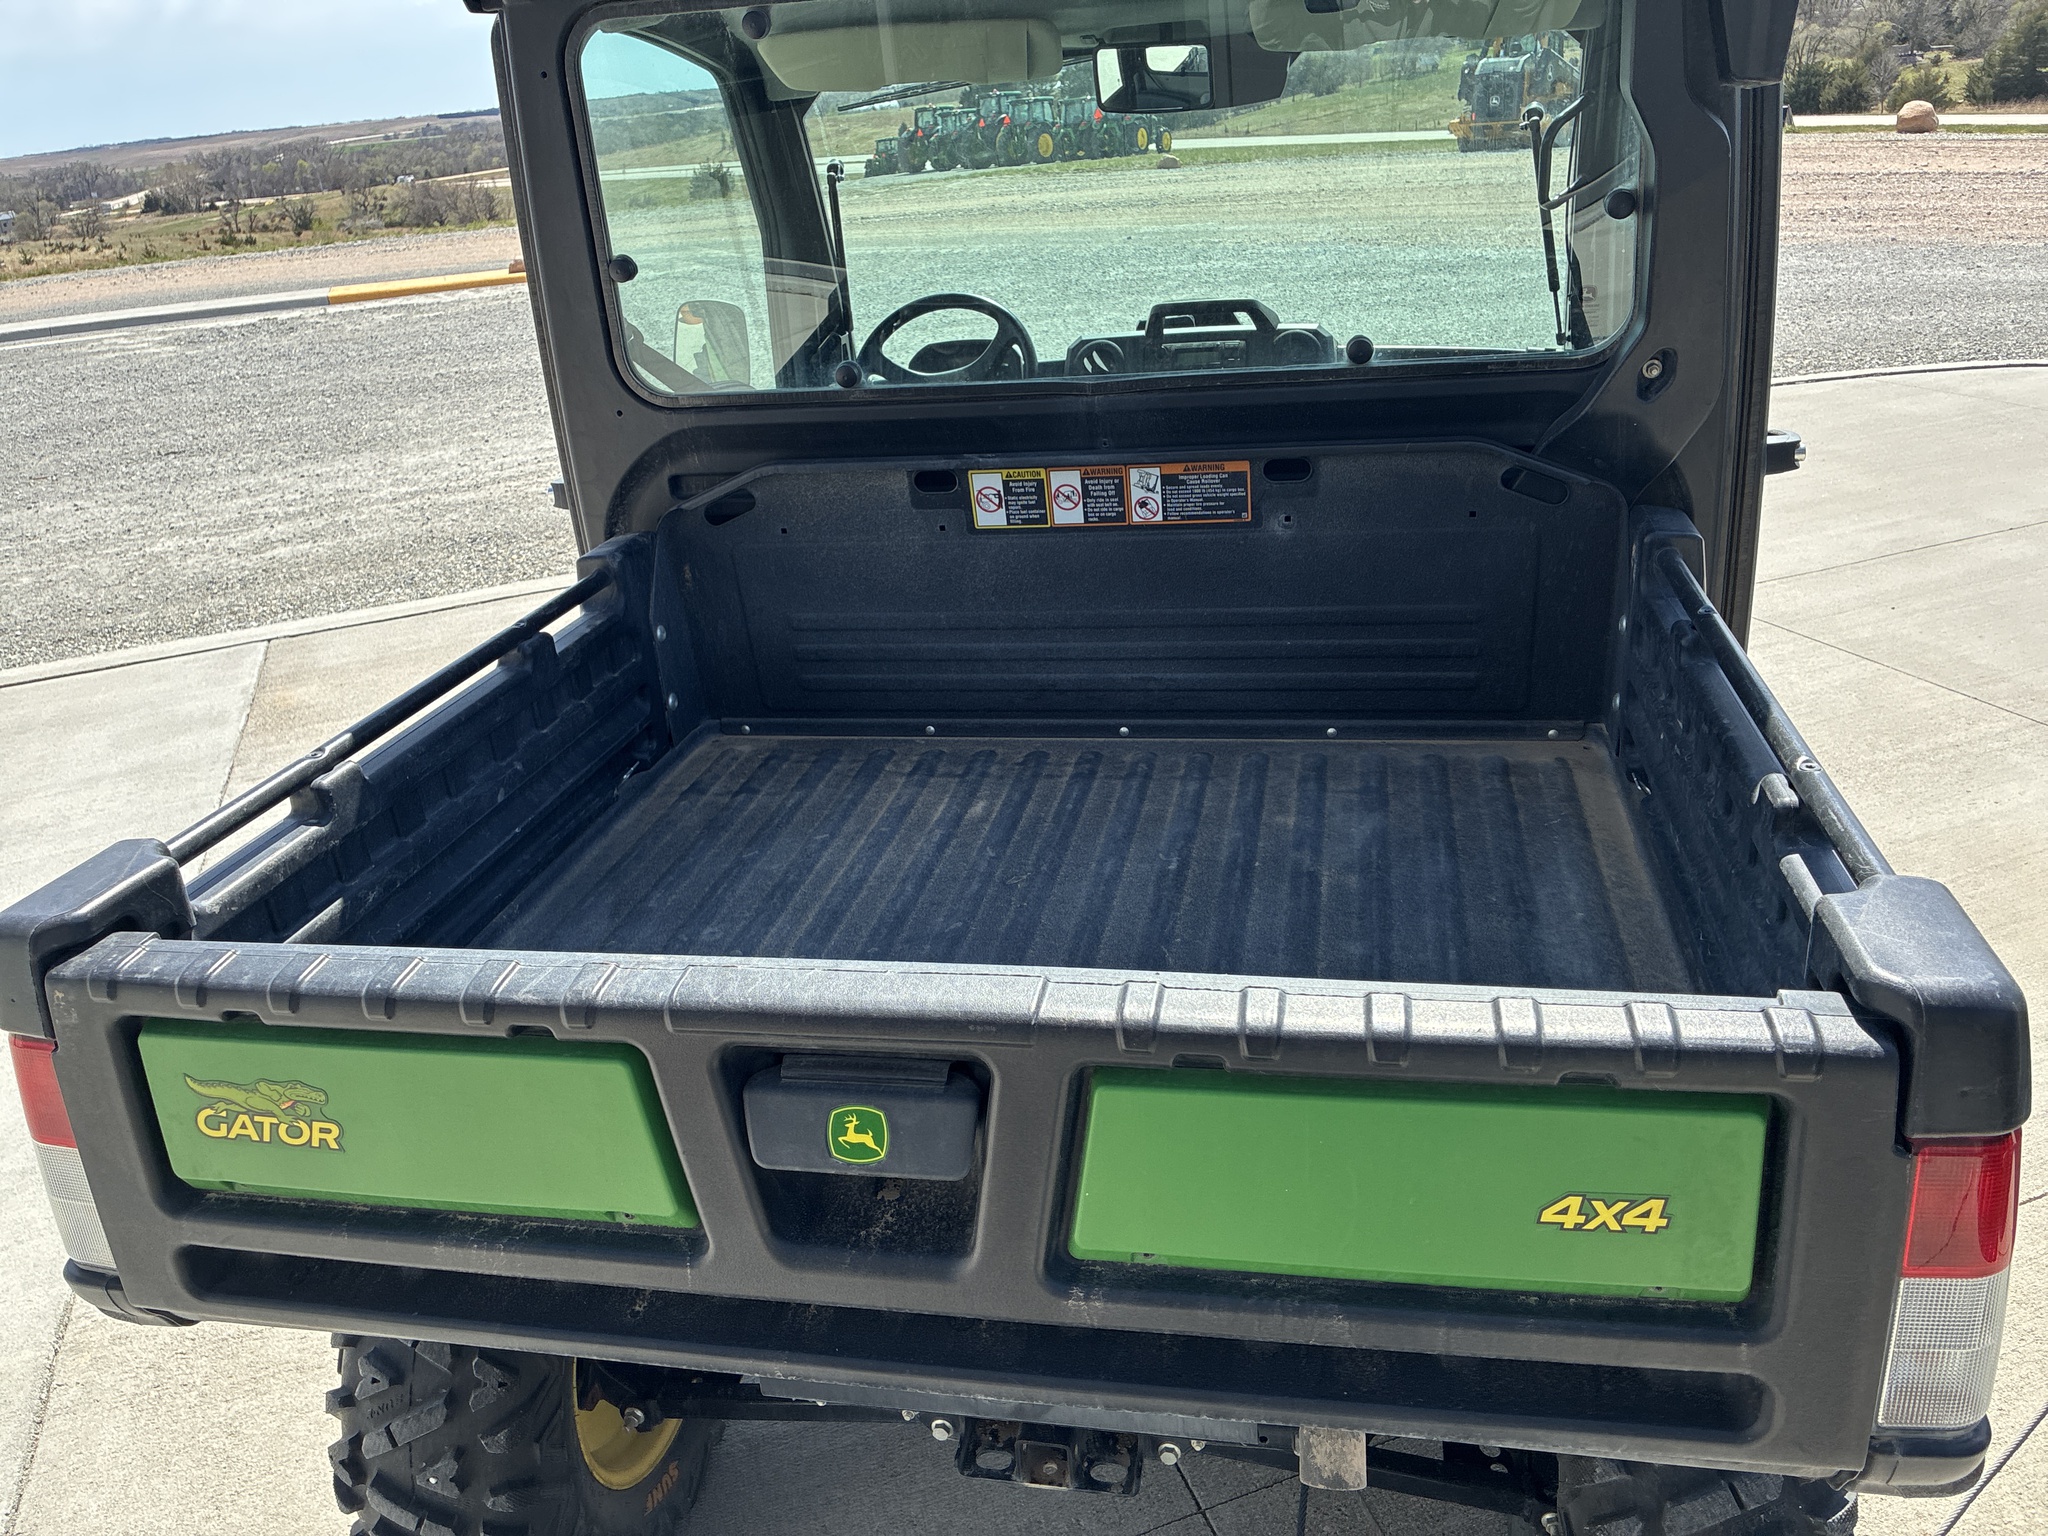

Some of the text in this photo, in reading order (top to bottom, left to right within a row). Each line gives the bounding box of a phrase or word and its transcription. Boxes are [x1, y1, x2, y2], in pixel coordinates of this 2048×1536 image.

[1090, 468, 1124, 476] WARNING
[1190, 464, 1225, 472] WARNING
[195, 1107, 343, 1151] GATOR
[1538, 1194, 1670, 1234] 4x4
